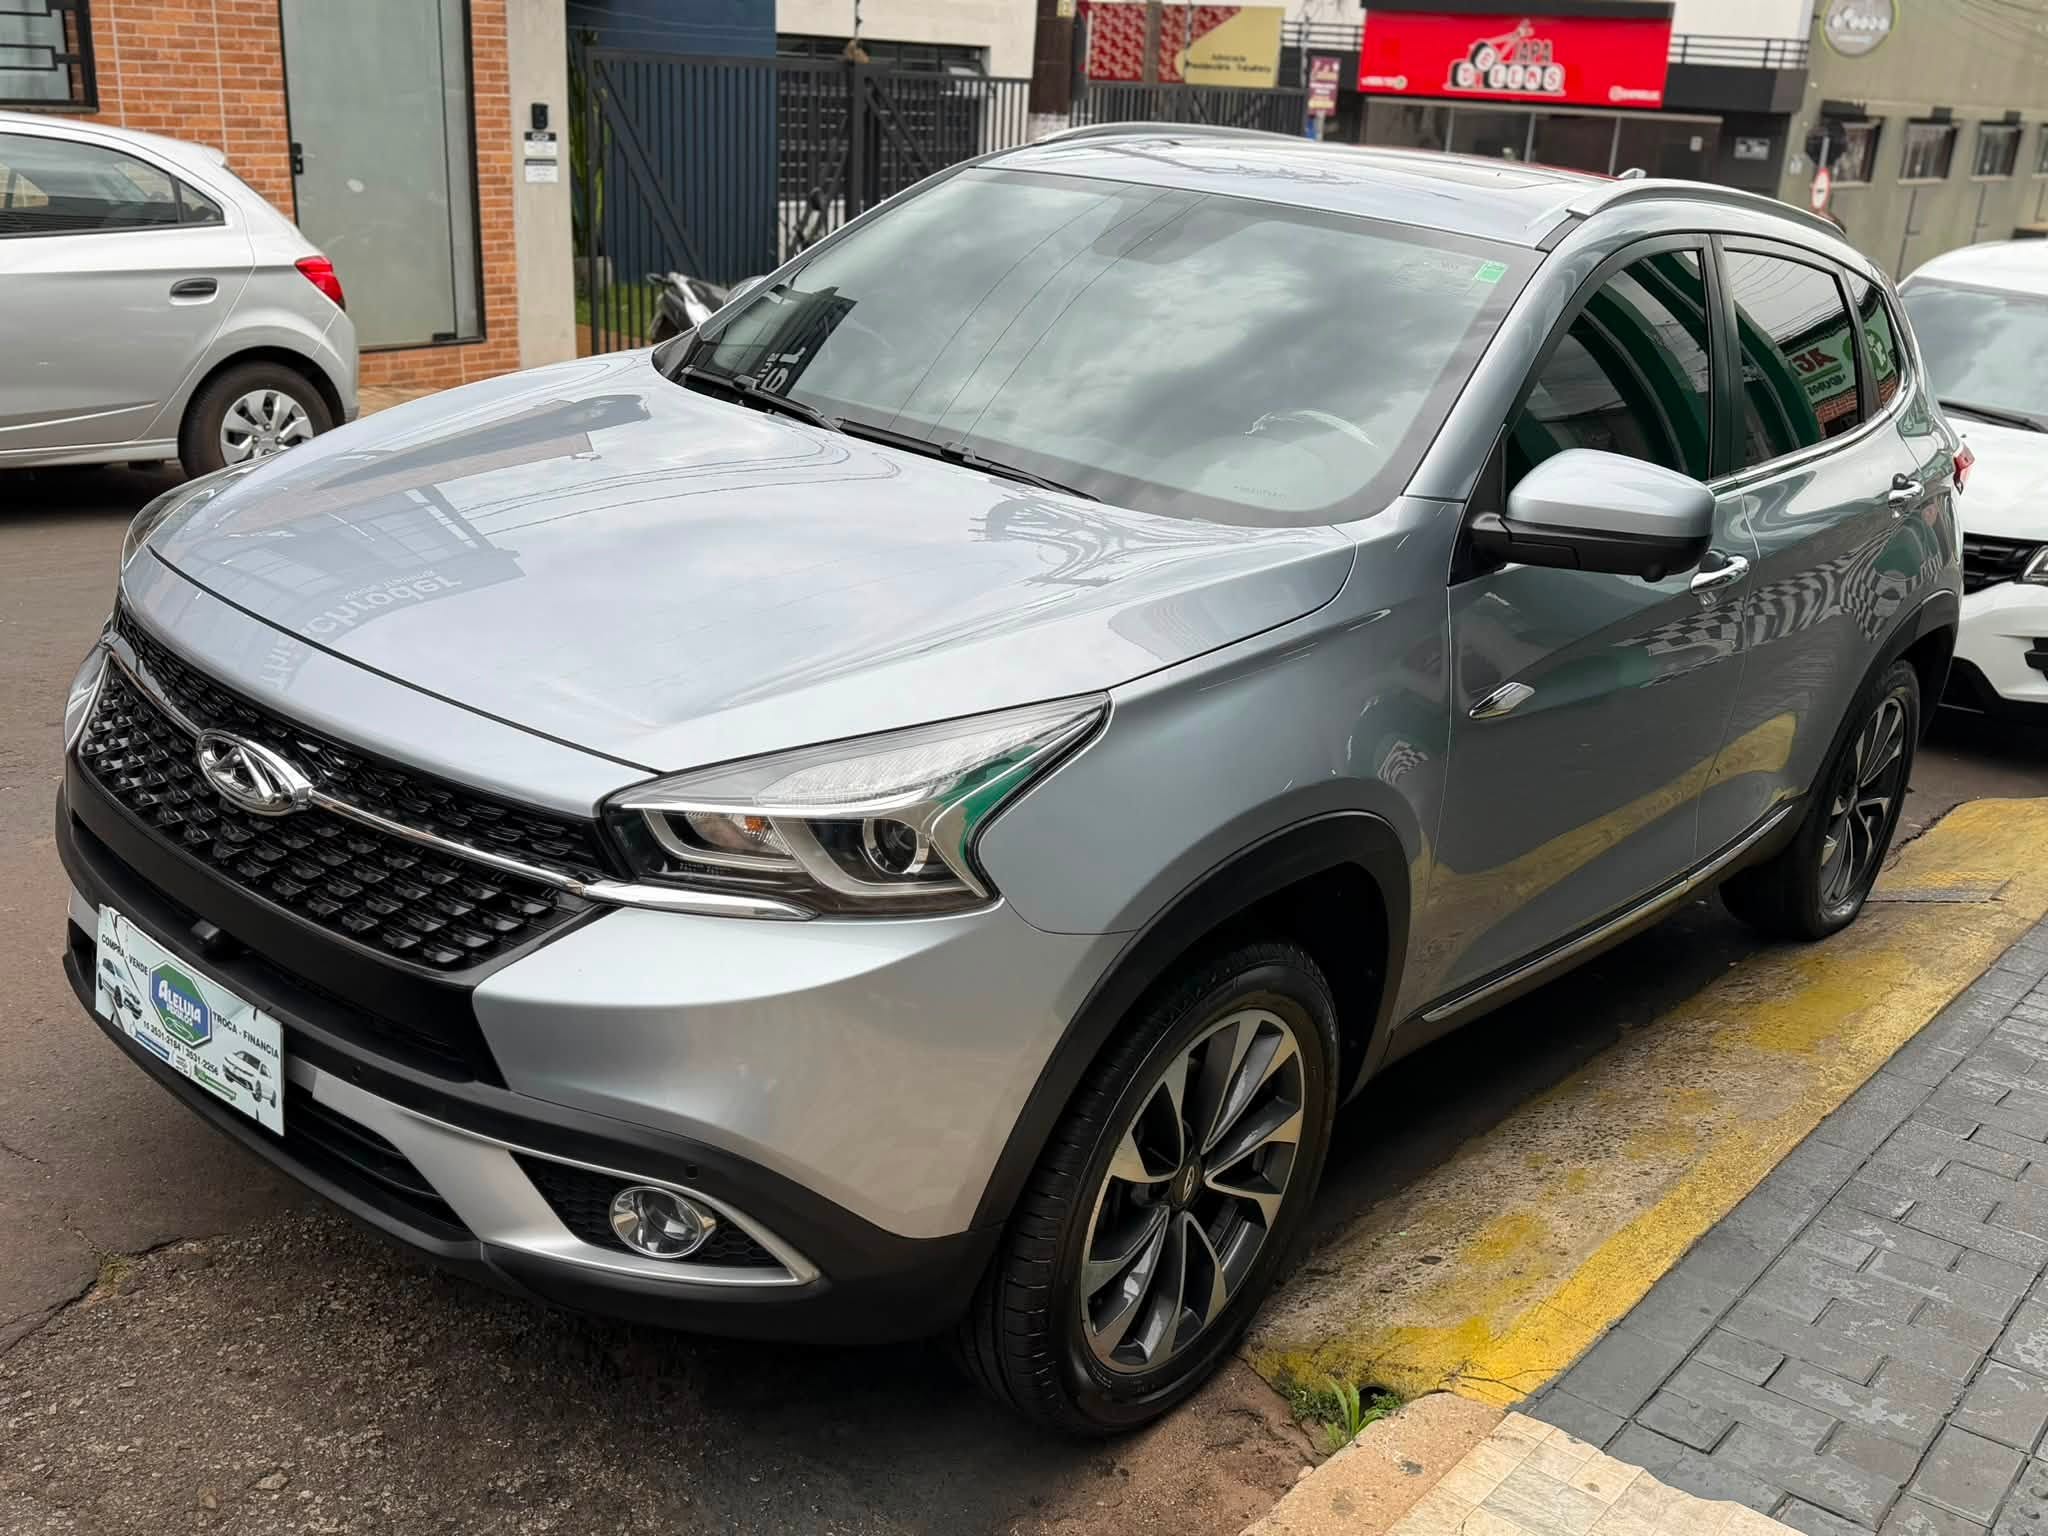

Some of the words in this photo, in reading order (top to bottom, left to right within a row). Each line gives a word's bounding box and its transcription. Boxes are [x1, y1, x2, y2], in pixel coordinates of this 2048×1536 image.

[101, 933, 125, 961] COMPRA
[128, 956, 149, 976] VENDE
[158, 979, 201, 1024] ALELUIA
[212, 1009, 238, 1035] TROCA
[243, 1030, 280, 1060] FINANCIA
